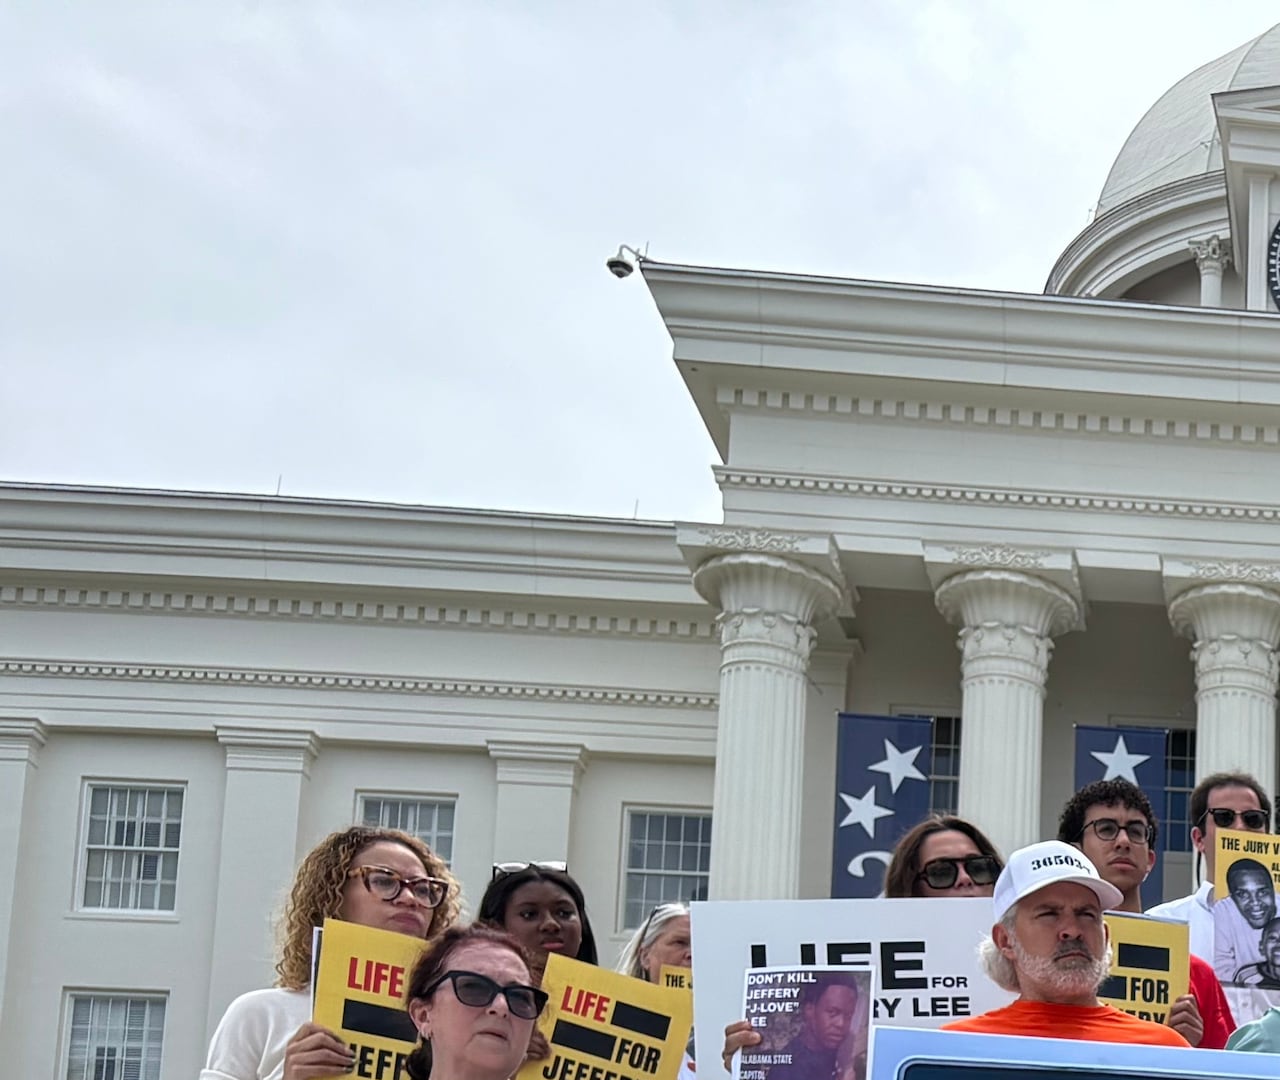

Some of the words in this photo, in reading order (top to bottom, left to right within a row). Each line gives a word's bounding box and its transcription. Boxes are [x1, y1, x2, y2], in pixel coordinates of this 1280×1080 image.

[1221, 837, 1240, 851] THE
[1243, 840, 1270, 855] JURY
[347, 956, 405, 999] LIFE
[666, 974, 685, 988] THE
[748, 973, 784, 985] DON'T
[787, 972, 817, 983] KILL
[931, 976, 968, 989] FOR
[747, 987, 800, 1000] JEFFERY
[1130, 977, 1169, 1004] FOR
[560, 985, 611, 1023] LIFE
[912, 996, 971, 1017] LEE
[615, 1037, 662, 1074] FOR
[773, 1054, 793, 1064] STATE
